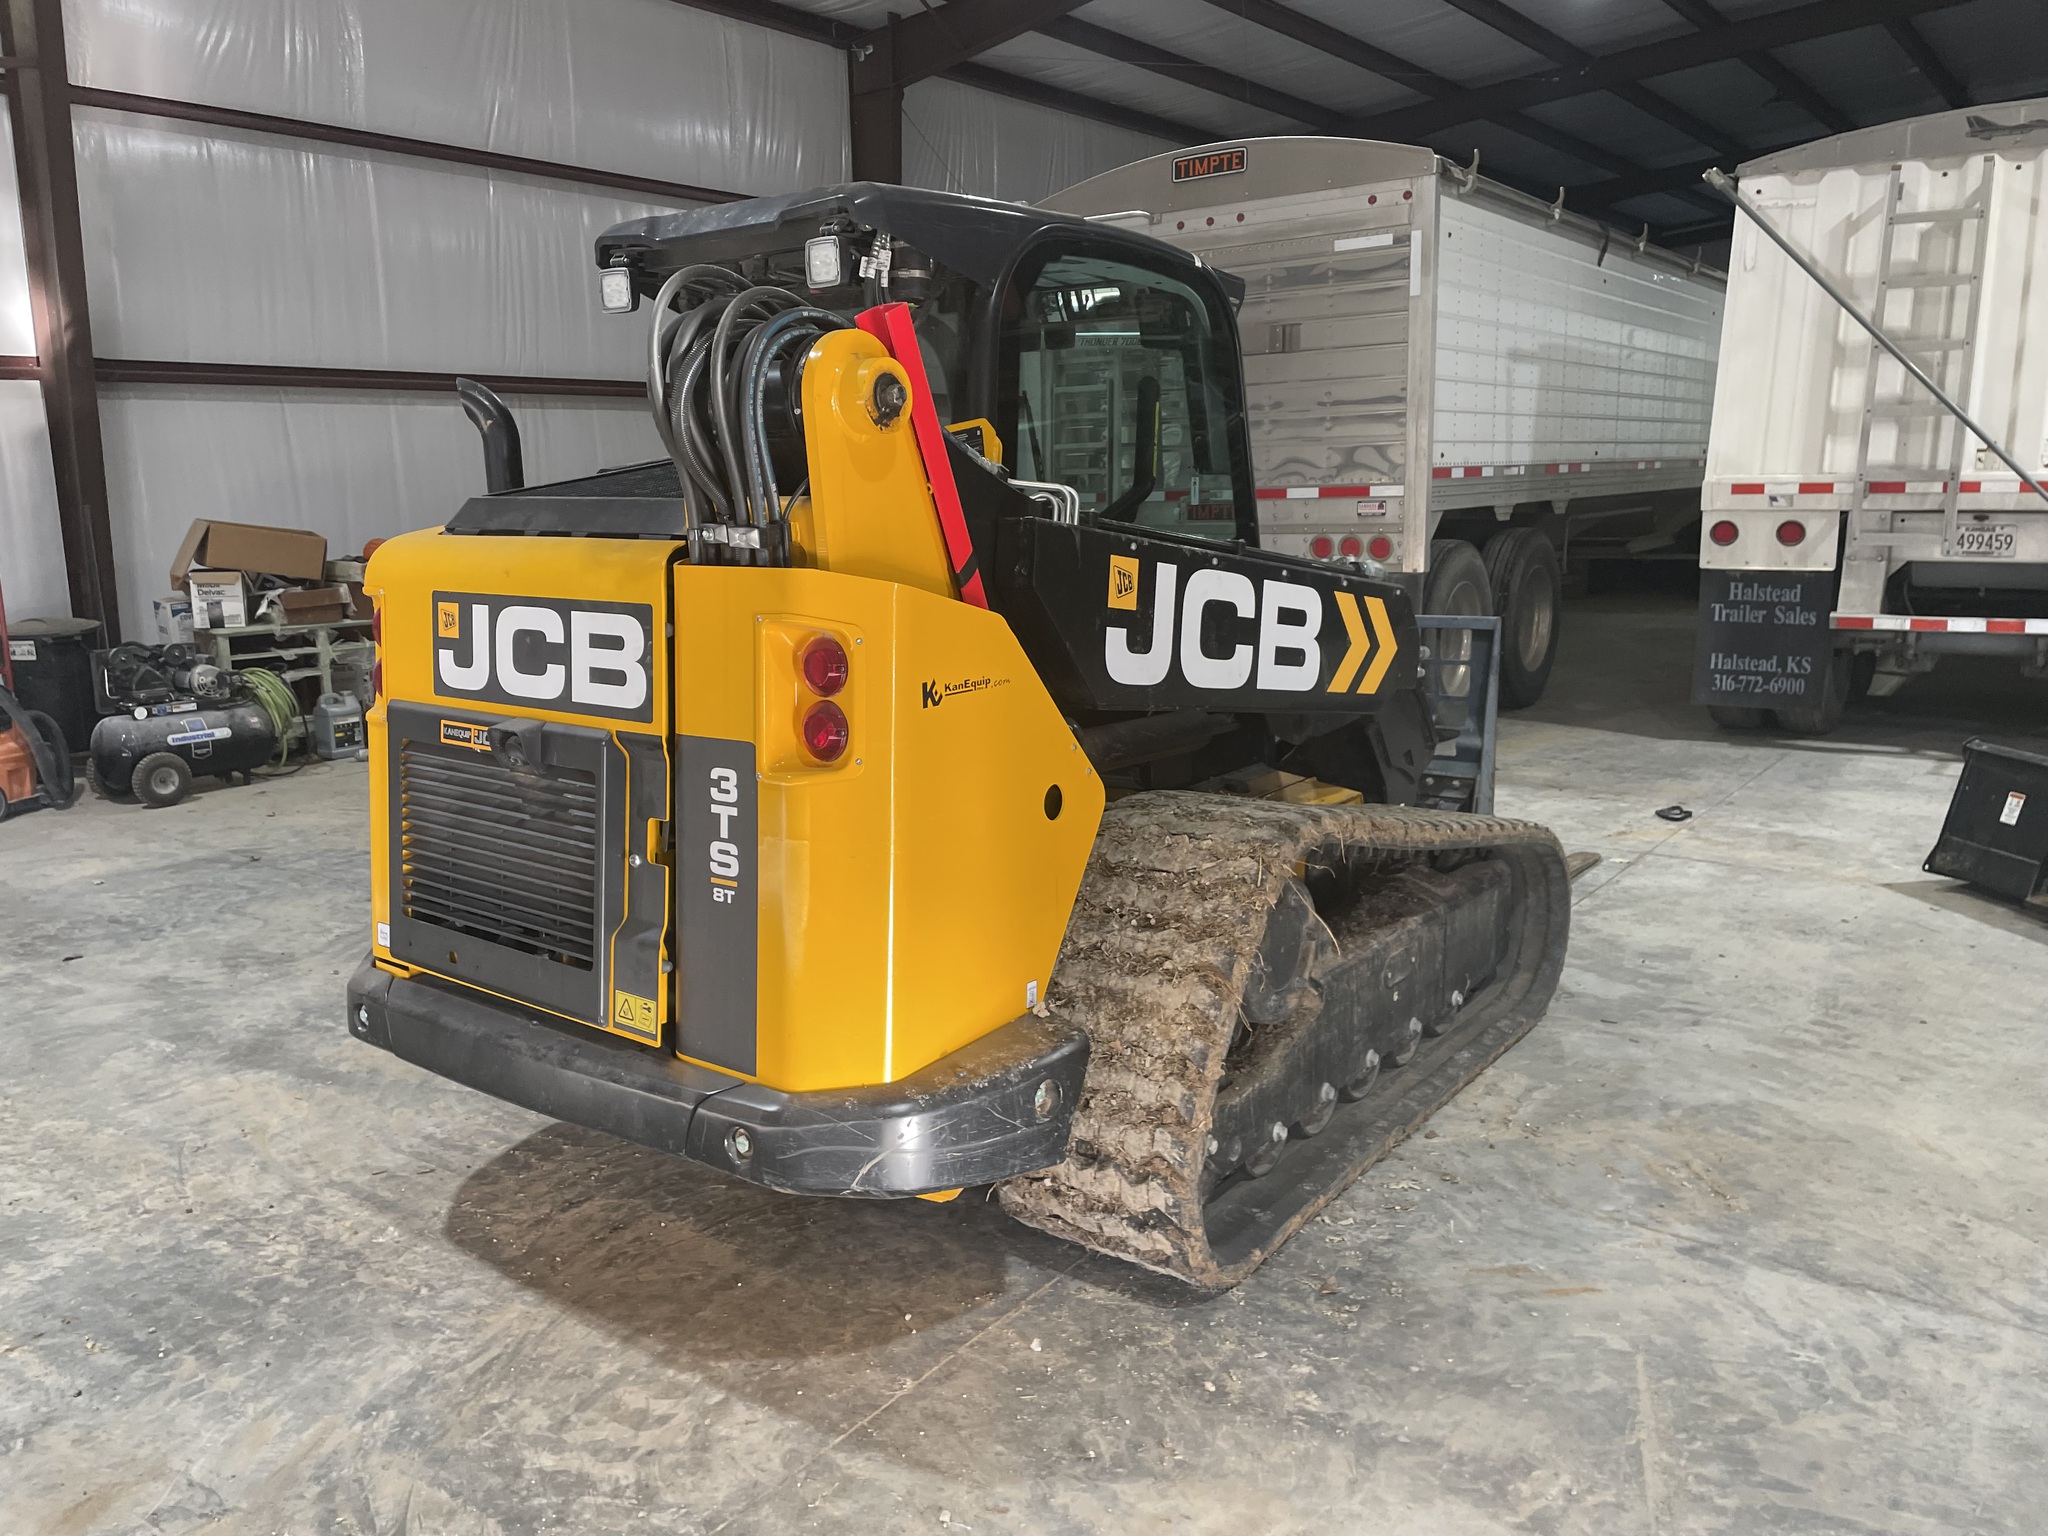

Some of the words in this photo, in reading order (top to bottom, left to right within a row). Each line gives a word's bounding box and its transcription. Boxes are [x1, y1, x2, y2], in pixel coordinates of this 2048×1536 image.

[1177, 152, 1242, 178] TIMPTE
[1080, 337, 1118, 347] THUNDER
[1956, 533, 2014, 550] 499459
[197, 589, 226, 597] Delvac
[1117, 569, 1133, 595] JCB
[1728, 582, 1802, 602] Halstead
[1710, 603, 1767, 624] Trailer
[1774, 605, 1818, 626] Sales
[1105, 562, 1323, 692] JCB
[438, 604, 648, 710] JCB
[1709, 653, 1782, 676] Halstead,
[1786, 656, 1812, 675] KS
[1711, 674, 1806, 696] 316-772-6900
[171, 731, 216, 744] Industrial
[712, 887, 736, 904] 8T
